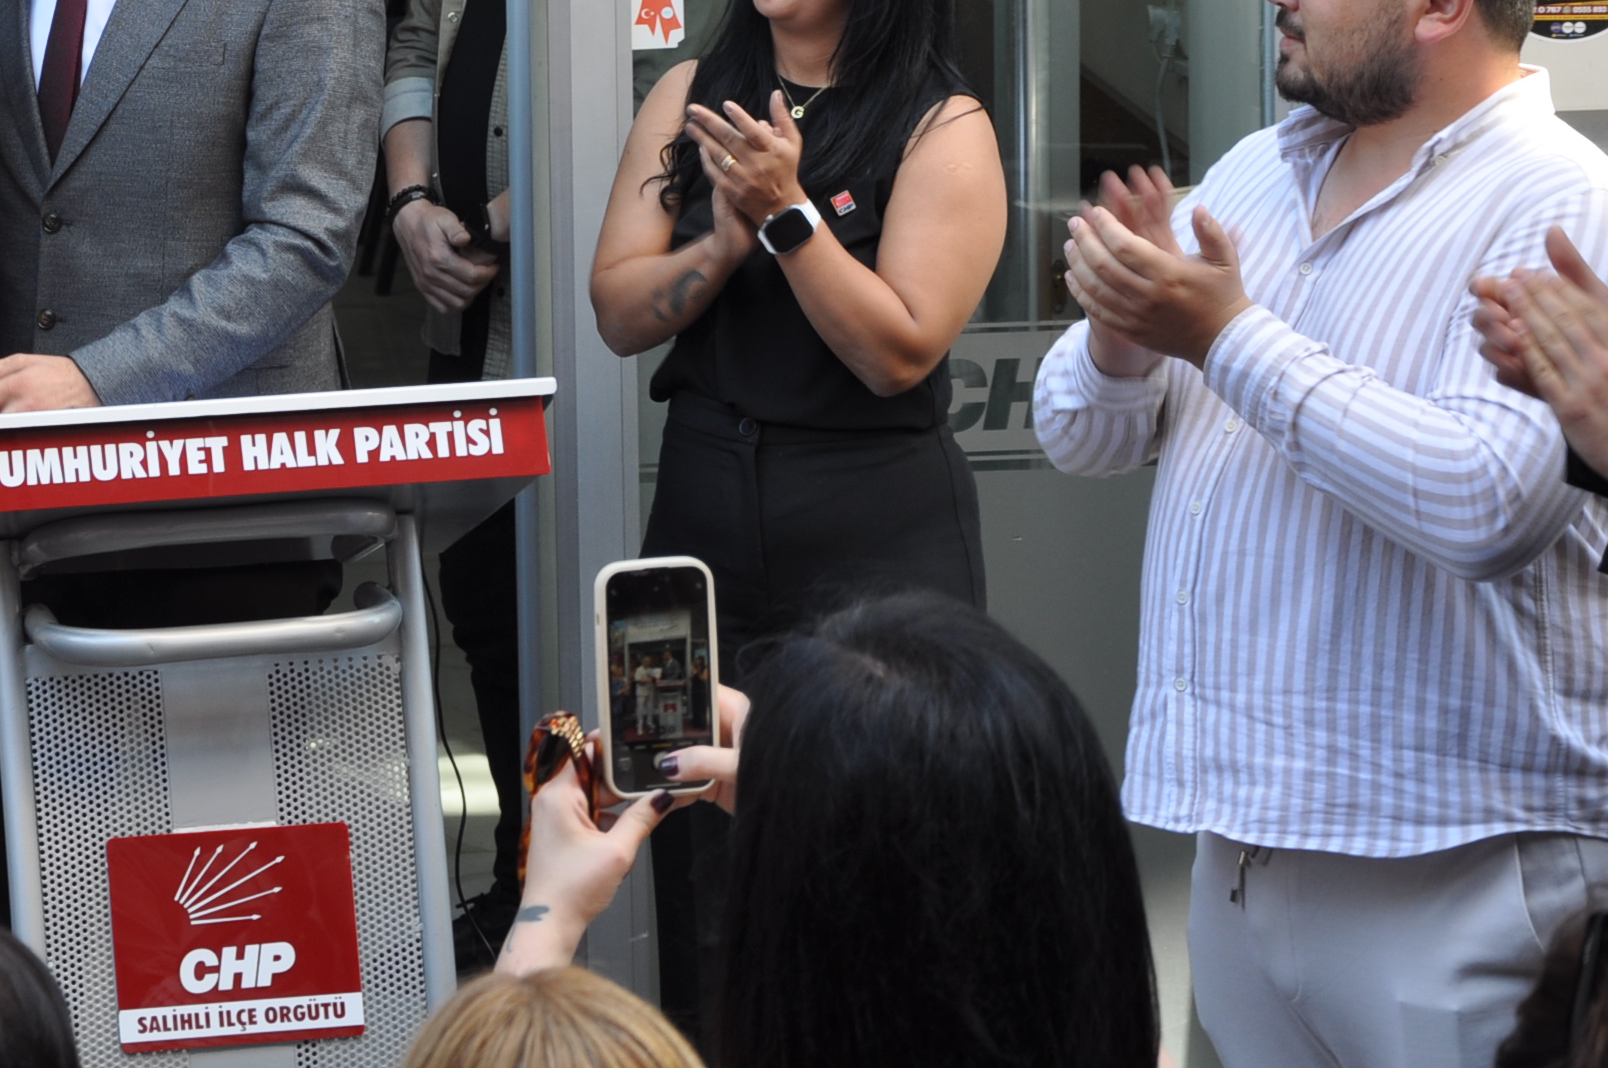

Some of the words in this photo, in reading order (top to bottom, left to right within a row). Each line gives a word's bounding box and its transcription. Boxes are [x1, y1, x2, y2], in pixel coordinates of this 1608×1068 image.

[241, 428, 343, 472] HALK
[355, 408, 503, 463] PARTİSİ
[180, 942, 296, 994] CHP
[137, 1005, 211, 1034] SALİHLİ
[218, 1005, 258, 1032] İLÇE
